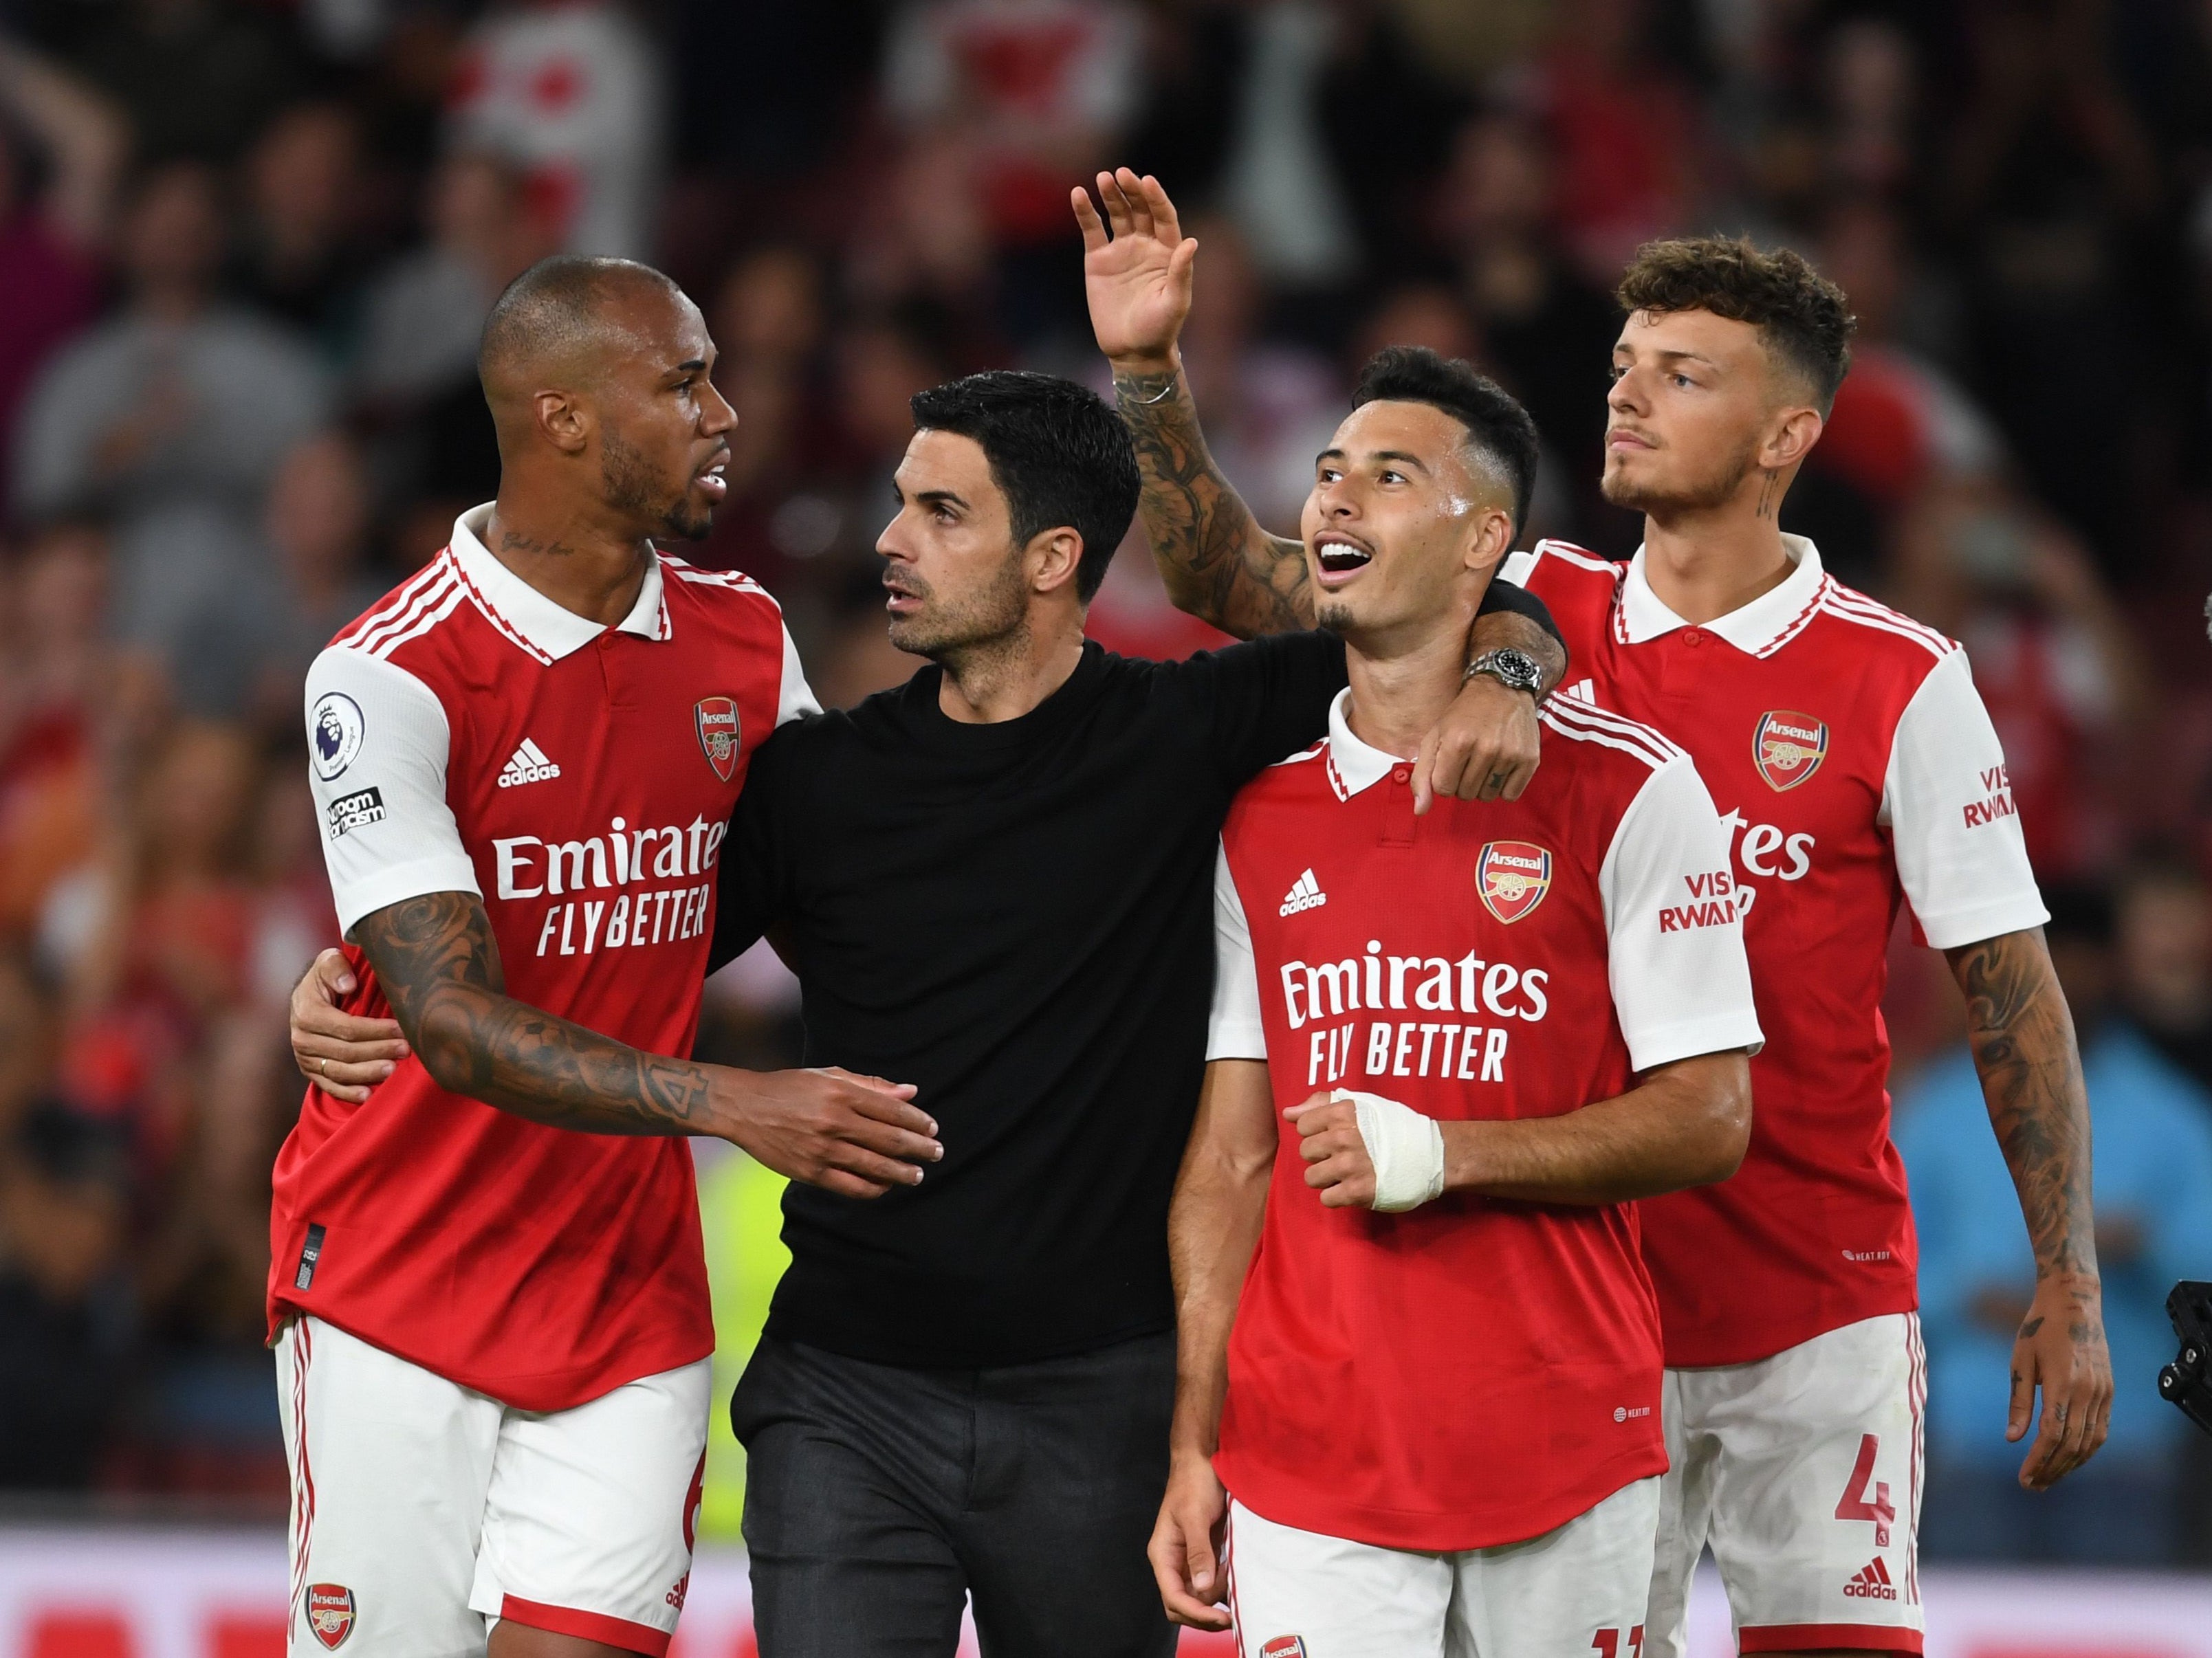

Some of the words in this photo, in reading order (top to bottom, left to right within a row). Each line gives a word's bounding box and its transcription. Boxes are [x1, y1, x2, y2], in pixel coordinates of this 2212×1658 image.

[701, 711, 734, 725] Arsenal
[1765, 720, 1819, 742] Arsenal
[497, 764, 561, 788] adidas
[491, 812, 730, 901] Emirate
[1487, 851, 1542, 870] Arsenal
[1684, 871, 1731, 899] VIS
[1279, 892, 1326, 918] adidas
[536, 900, 605, 957] FLY
[604, 883, 710, 948] BETTER
[1280, 940, 1549, 1030] Emirates
[1308, 1022, 1355, 1086] FLY
[1365, 1021, 1509, 1083] BETTER
[1834, 1433, 1896, 1548] 4
[311, 1592, 348, 1606] Arsenal
[1843, 1580, 1897, 1601] adidas
